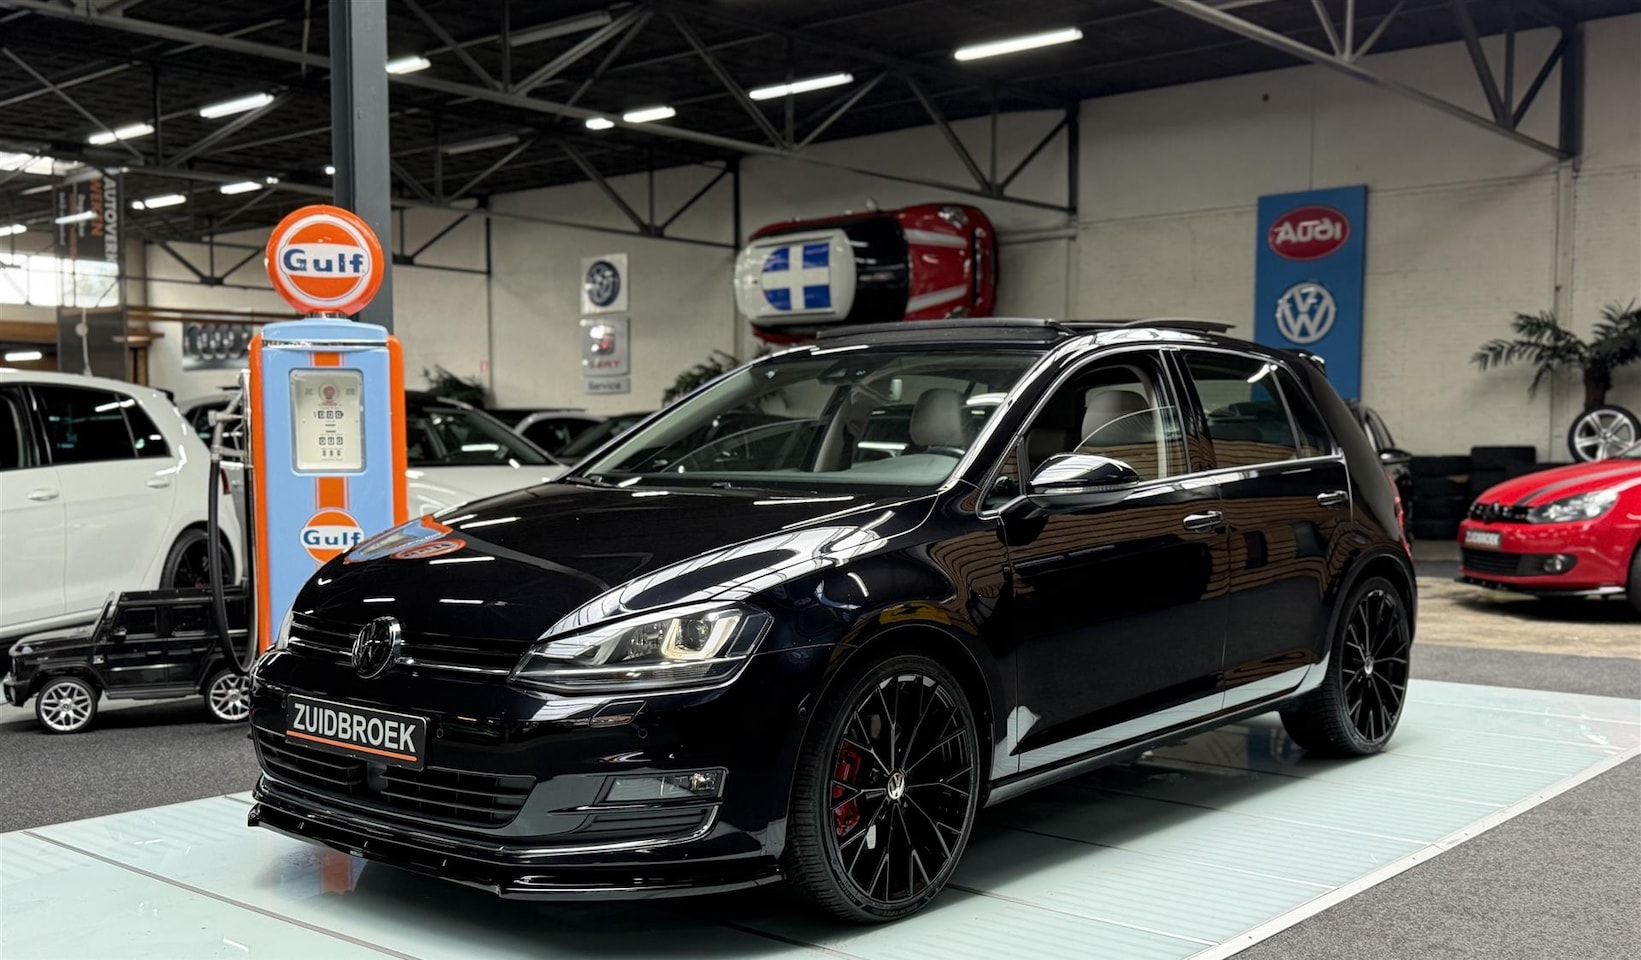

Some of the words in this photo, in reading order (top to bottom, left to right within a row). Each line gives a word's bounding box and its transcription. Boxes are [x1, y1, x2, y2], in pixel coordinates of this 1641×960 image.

[283, 248, 365, 275] Gulf
[303, 530, 361, 546] Gulf
[293, 703, 417, 753] ZUIDBROEK
